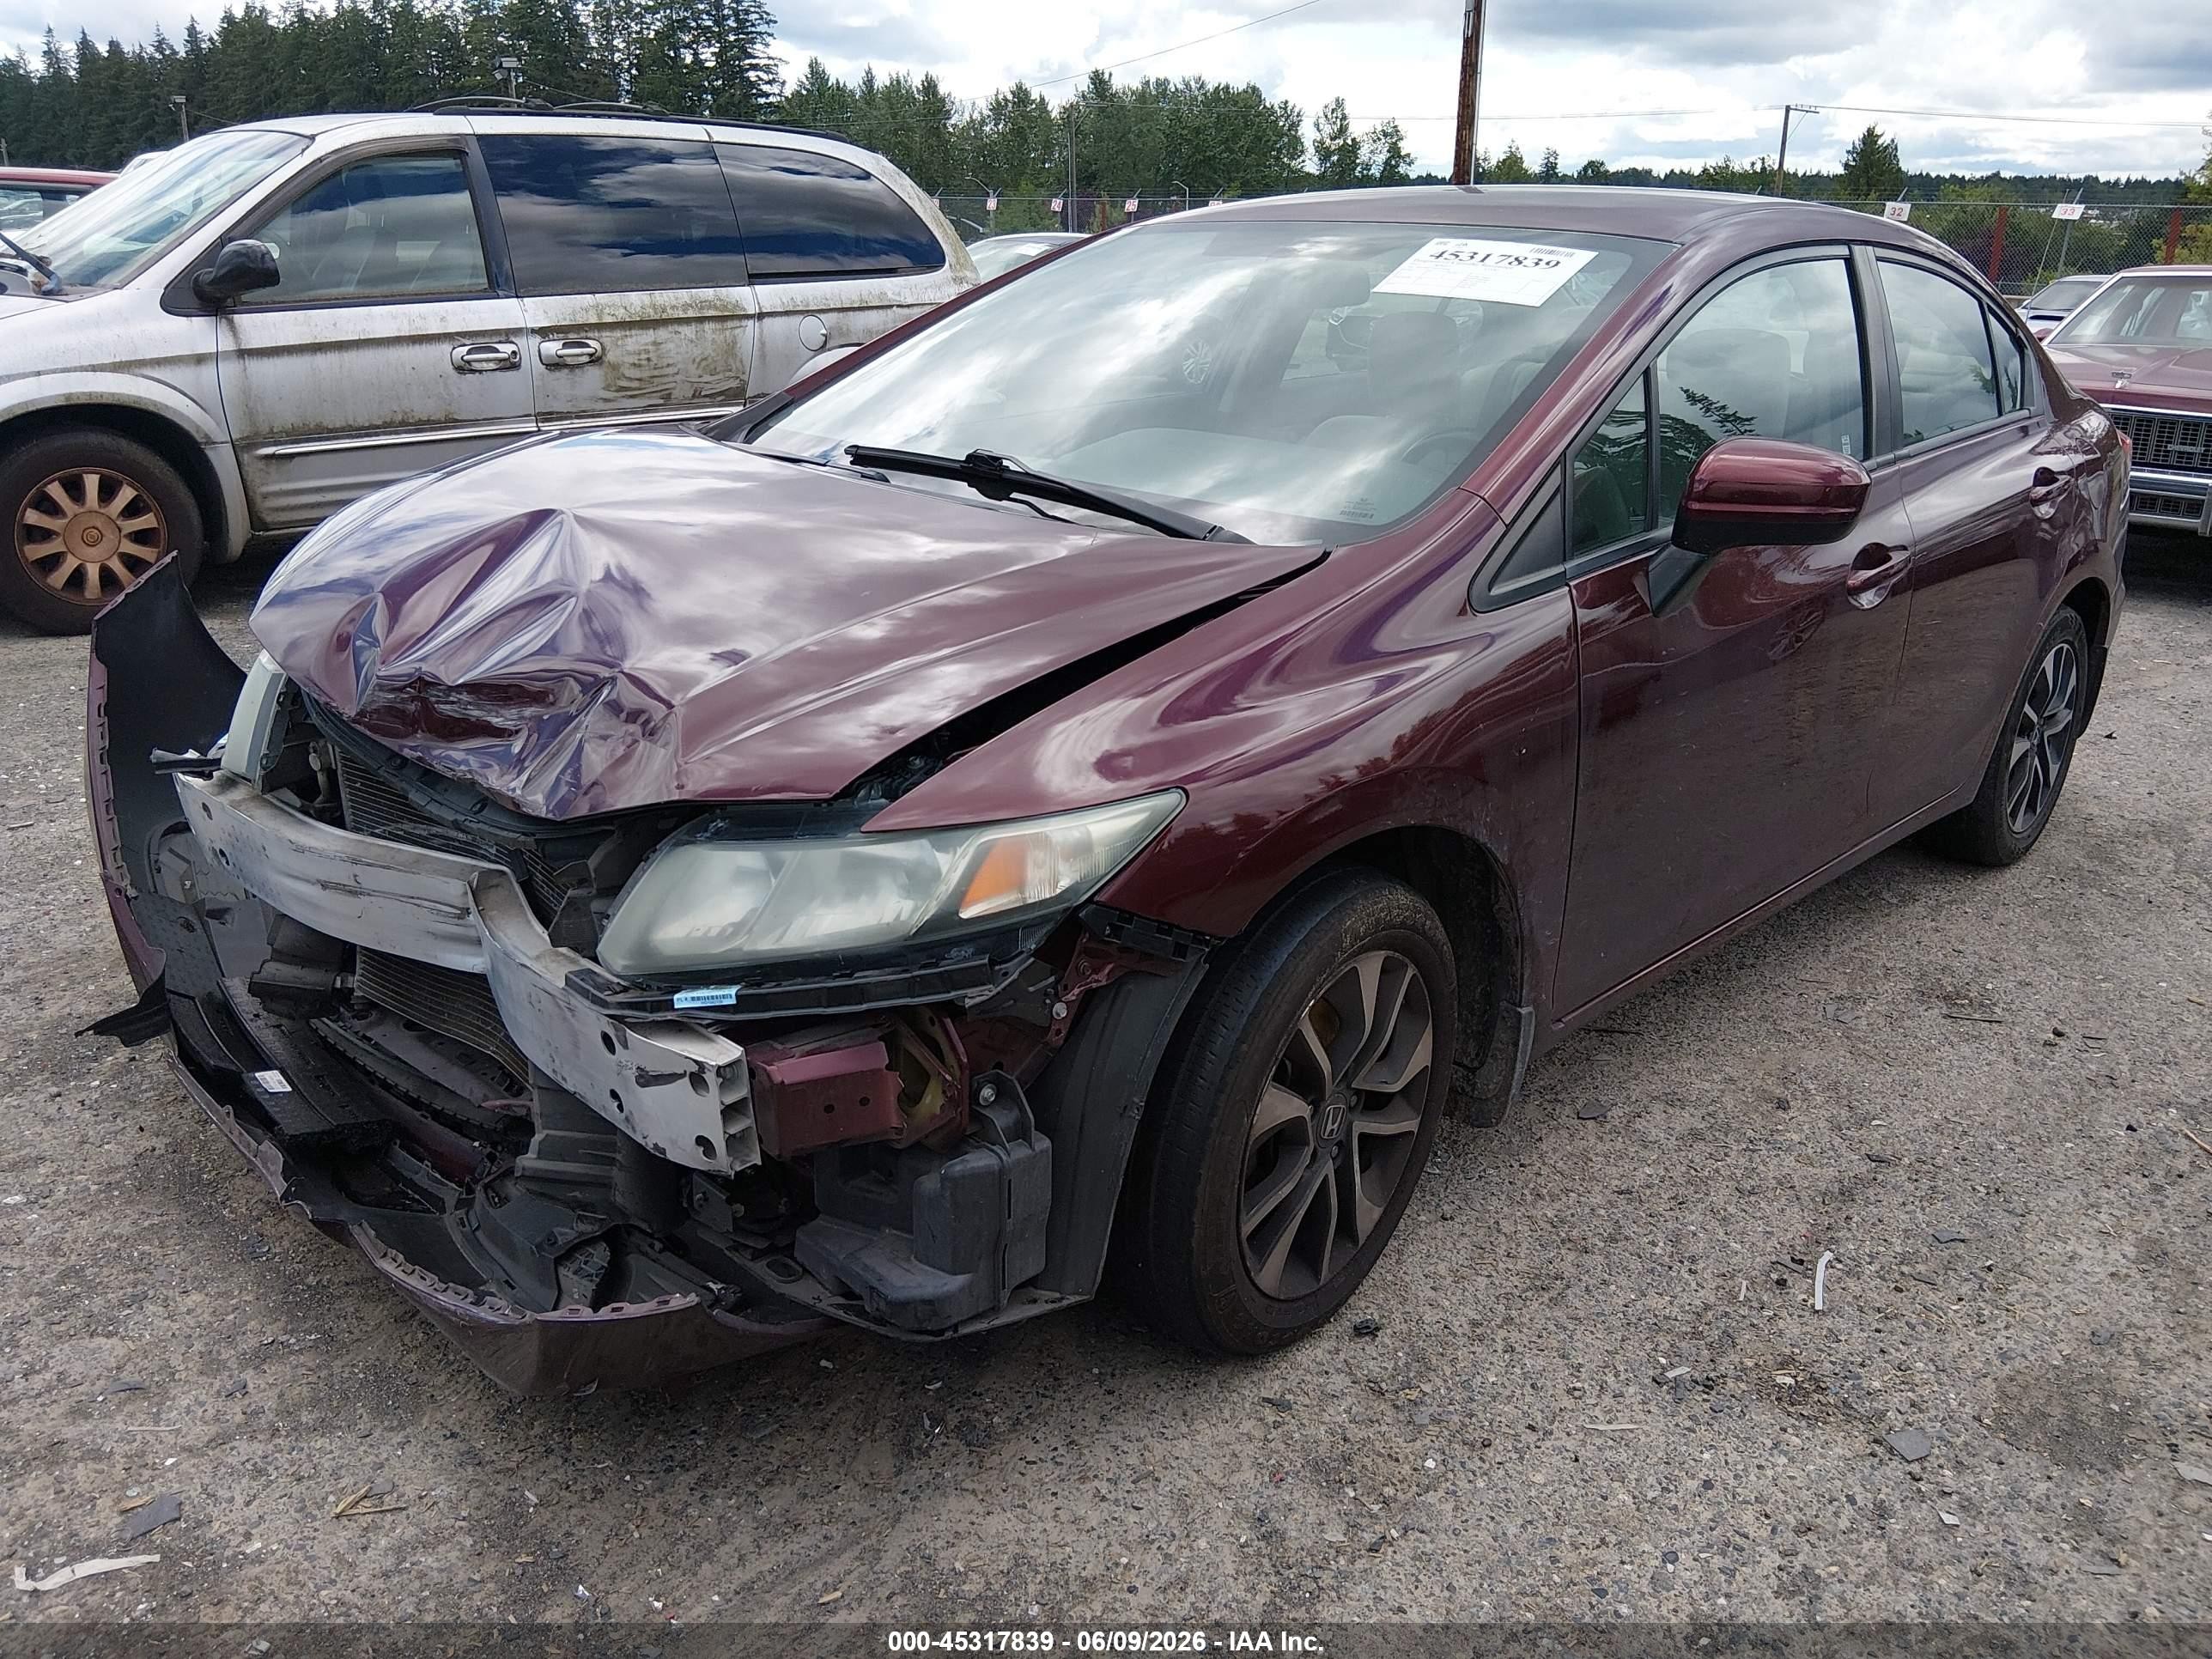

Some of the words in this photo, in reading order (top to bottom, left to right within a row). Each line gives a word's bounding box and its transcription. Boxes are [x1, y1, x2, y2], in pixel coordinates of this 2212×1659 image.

[1052, 199, 1062, 210] 24
[1126, 199, 1137, 211] 25
[1890, 206, 1904, 217] 32
[2060, 208, 2075, 216] 33
[1429, 250, 1561, 270] 45317839
